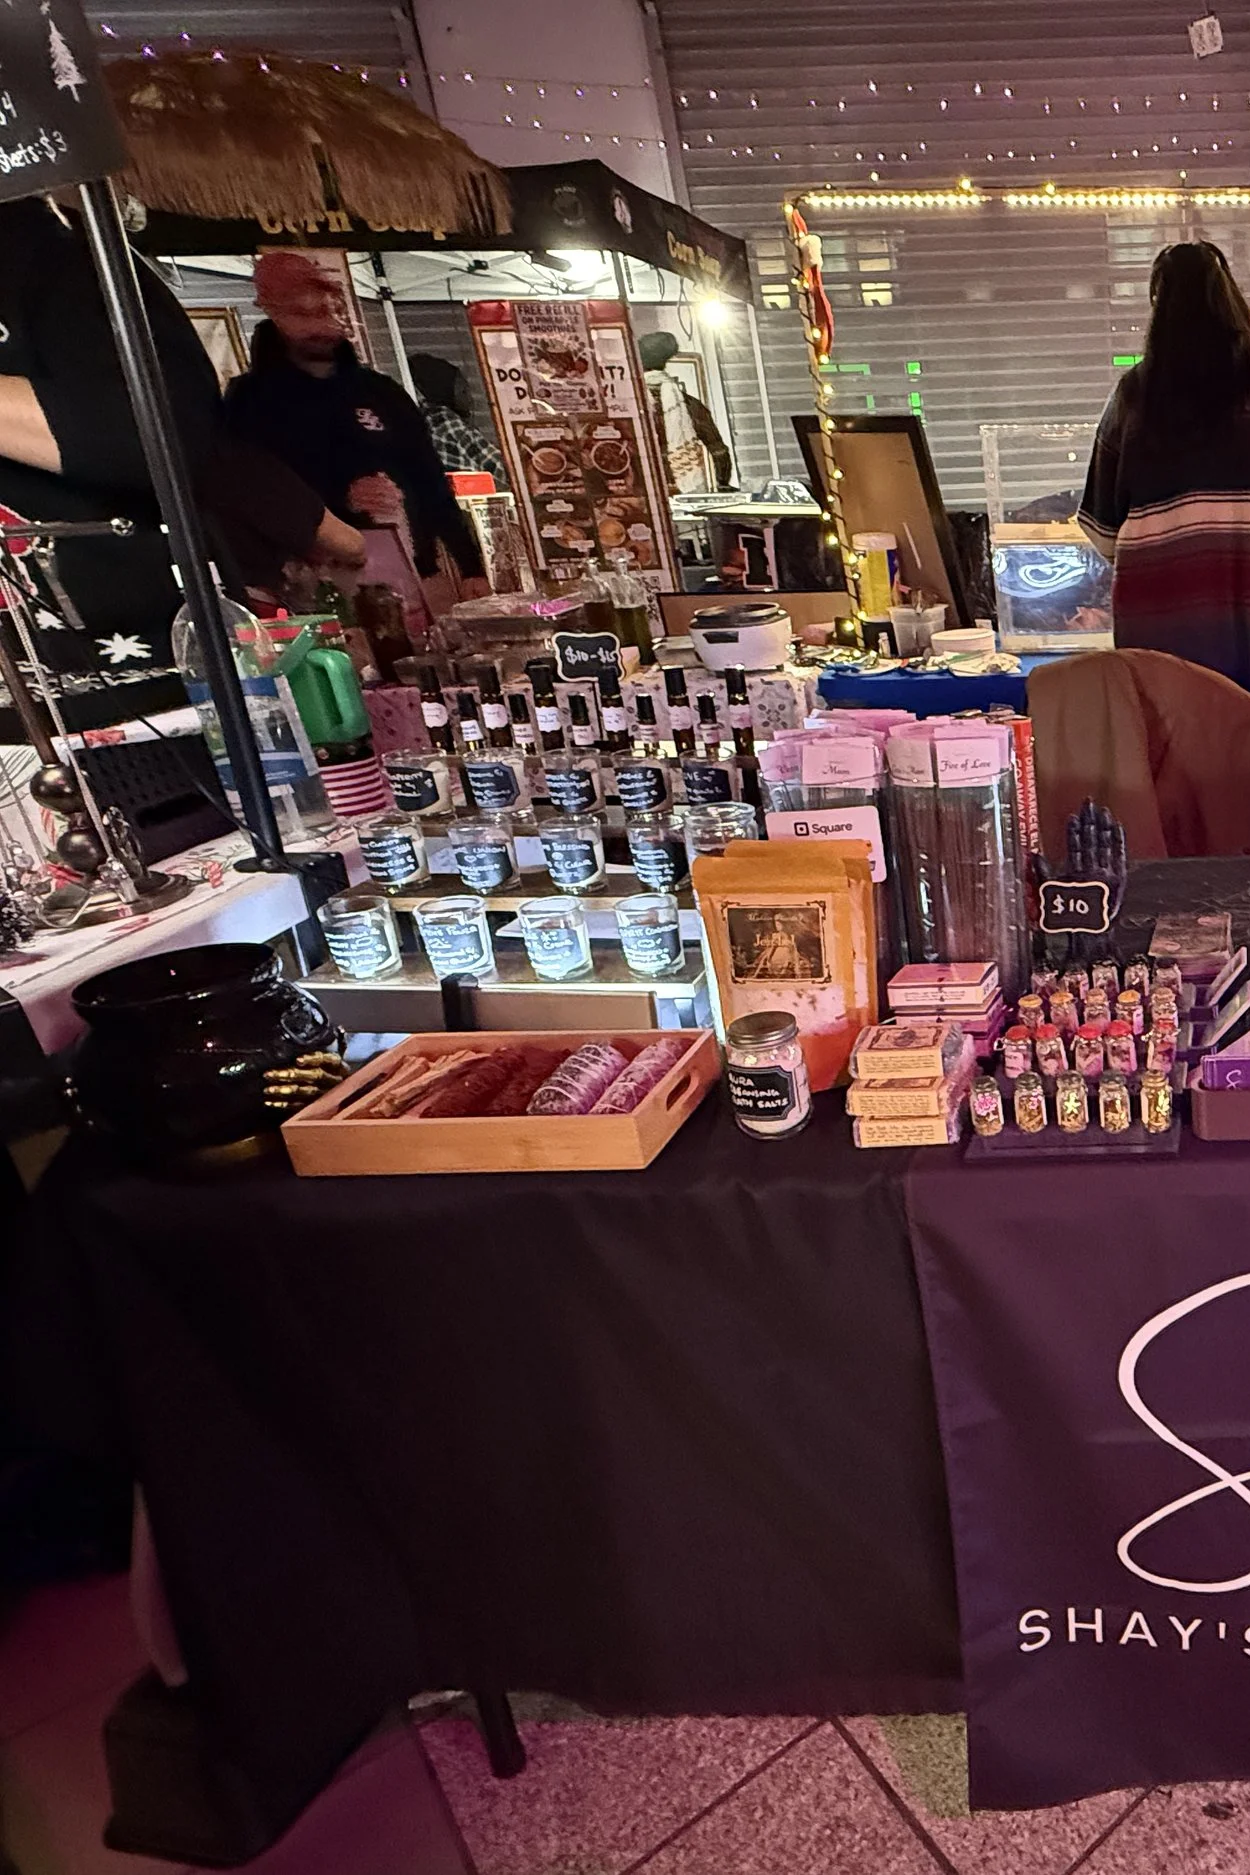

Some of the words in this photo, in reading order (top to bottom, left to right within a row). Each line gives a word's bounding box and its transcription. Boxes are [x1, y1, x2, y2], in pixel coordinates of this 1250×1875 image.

[517, 305, 542, 315] FREE
[960, 759, 970, 771] of
[971, 759, 992, 769] Love
[1016, 781, 1026, 820] AWAY
[811, 821, 853, 834] Square
[1051, 894, 1090, 914] $10
[757, 1098, 788, 1109] SALTS
